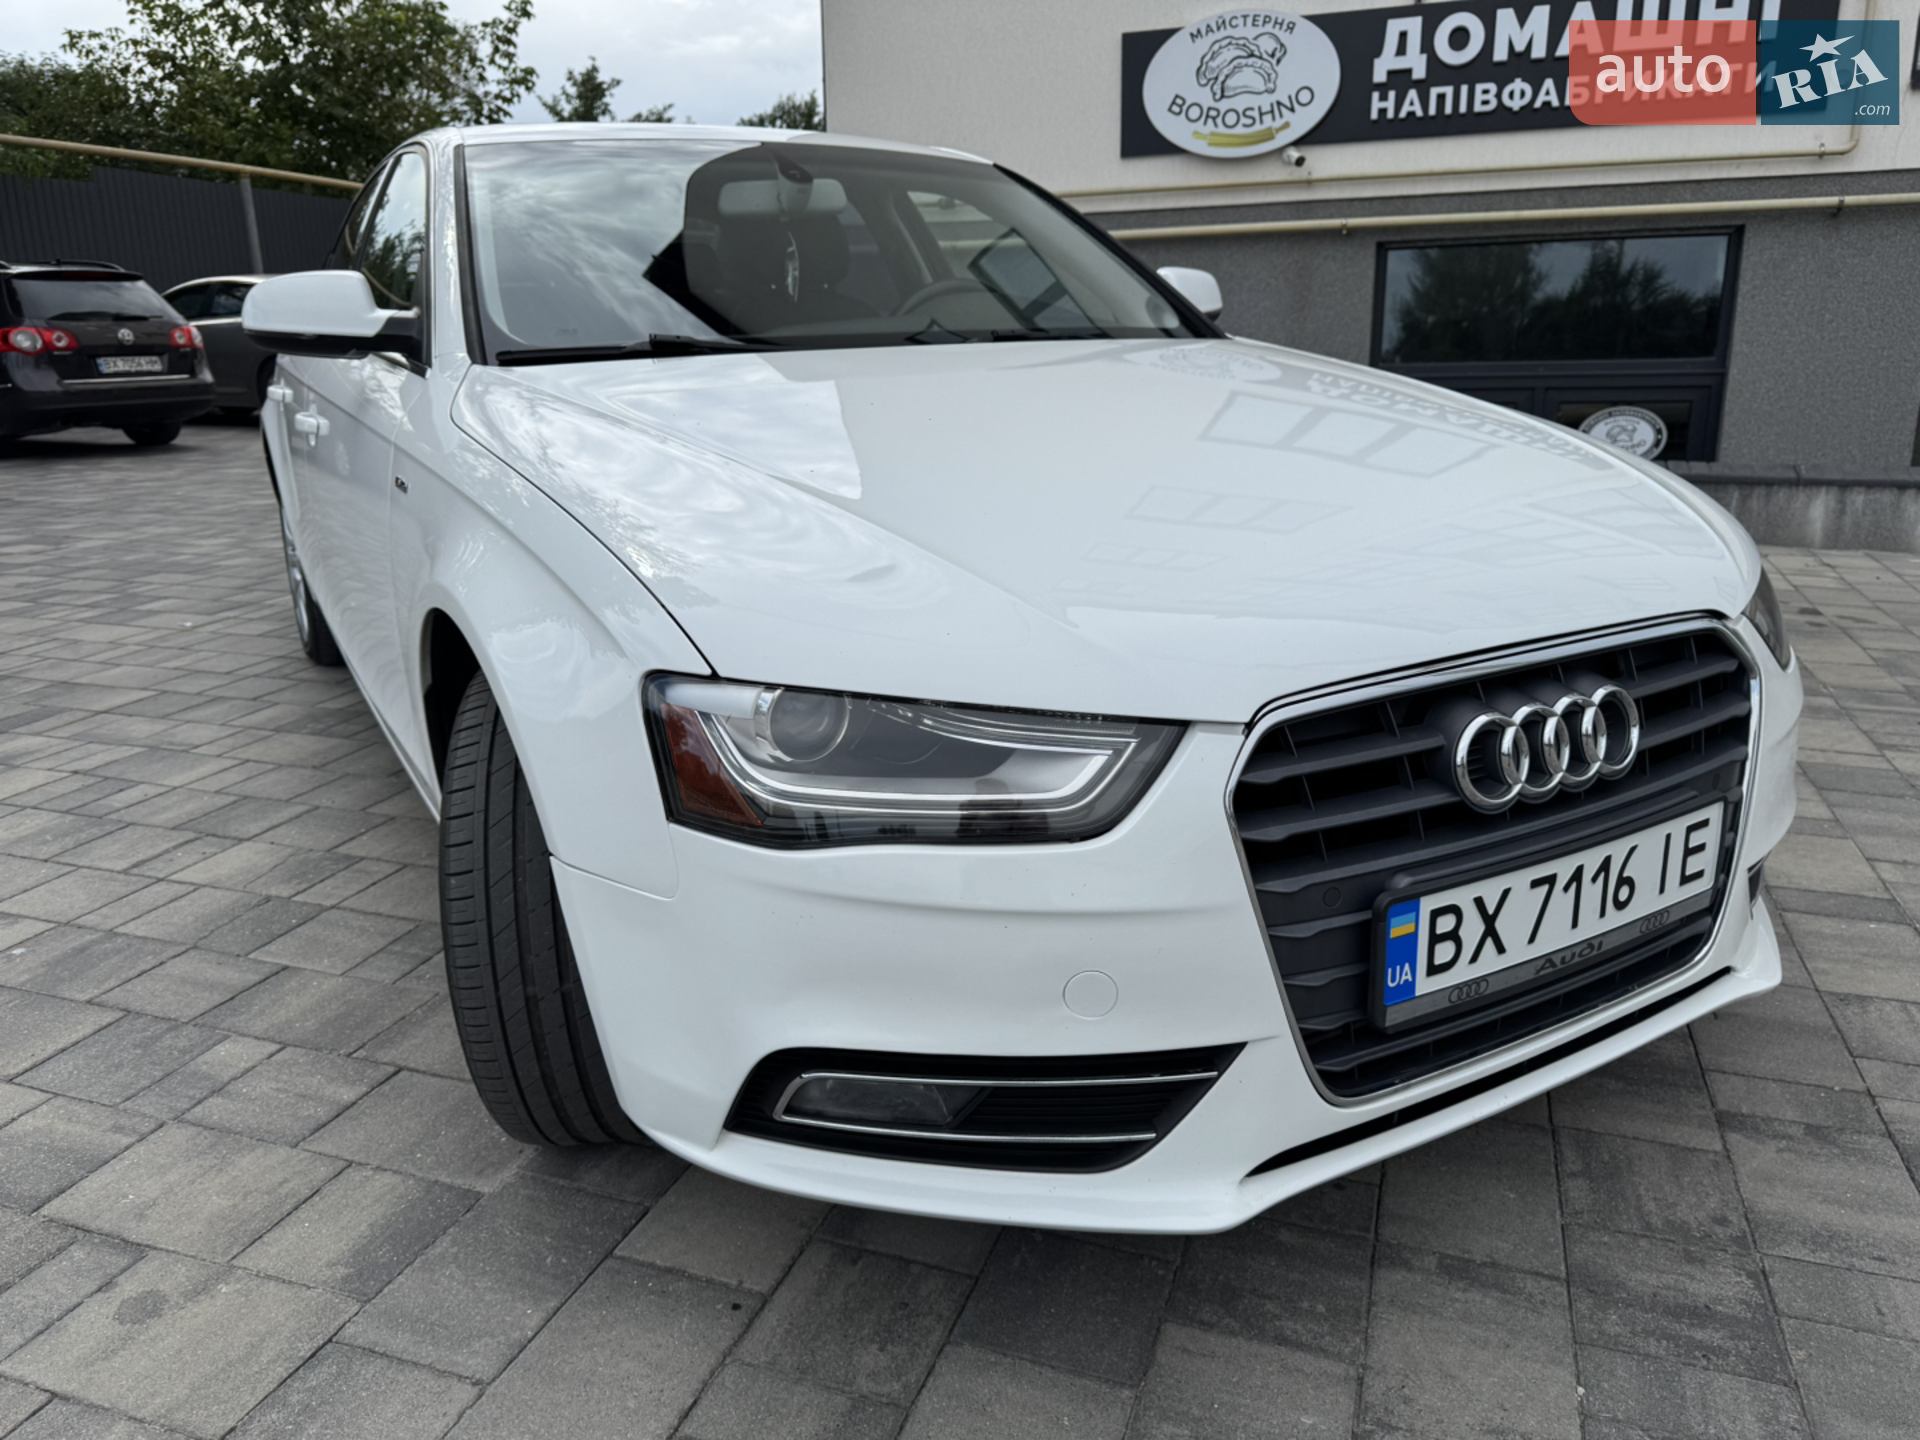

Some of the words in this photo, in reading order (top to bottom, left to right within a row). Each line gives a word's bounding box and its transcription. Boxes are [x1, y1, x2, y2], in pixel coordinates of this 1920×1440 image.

[1189, 14, 1297, 43] МАЙСТЕРНЯ
[1167, 85, 1315, 129] BOROSHNO
[1426, 887, 1512, 977] BX
[1528, 844, 1638, 945] 7116
[1659, 818, 1710, 895] IE
[1387, 962, 1413, 988] UA
[1534, 940, 1604, 975] Audi
